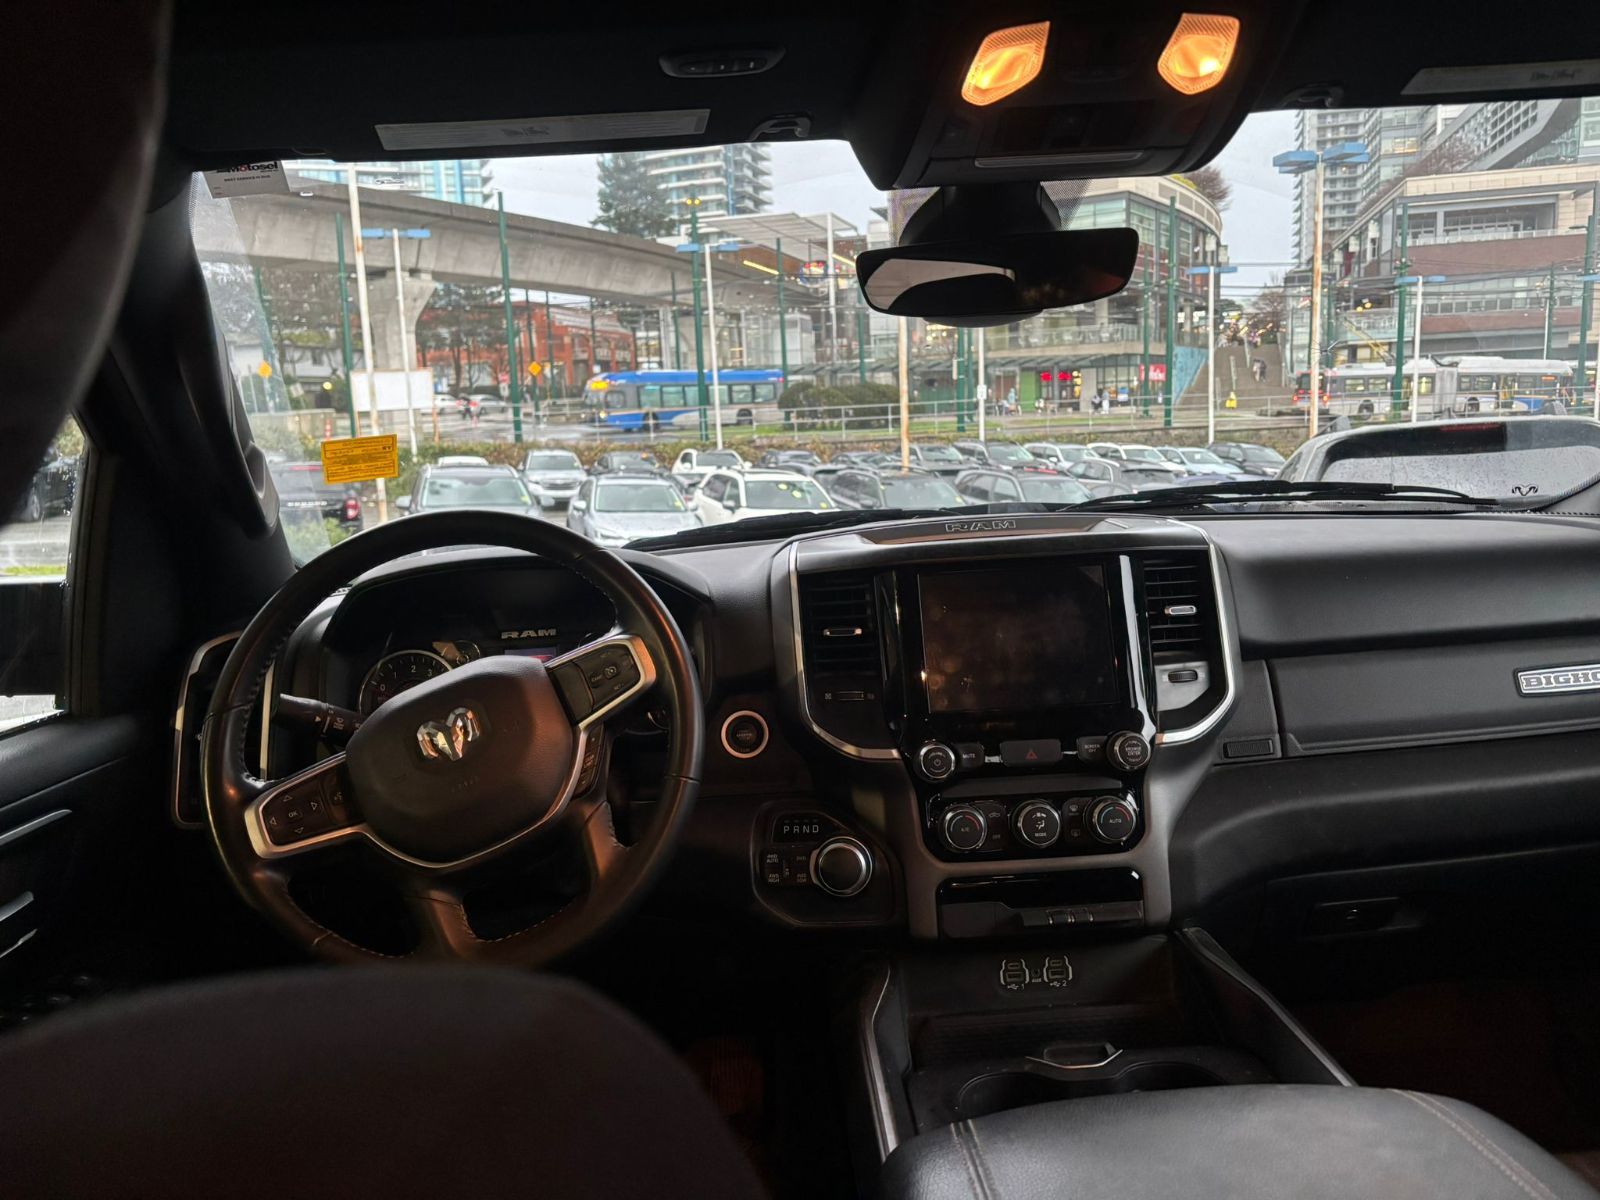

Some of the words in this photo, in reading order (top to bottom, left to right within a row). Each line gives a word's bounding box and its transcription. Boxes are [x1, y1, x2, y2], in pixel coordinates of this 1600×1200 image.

[944, 519, 1017, 532] RAM
[500, 628, 557, 640] RAM
[410, 664, 417, 673] 2
[288, 810, 299, 818] OK
[783, 825, 790, 834] P
[792, 825, 800, 834] R
[802, 825, 810, 833] N
[812, 824, 820, 833] D
